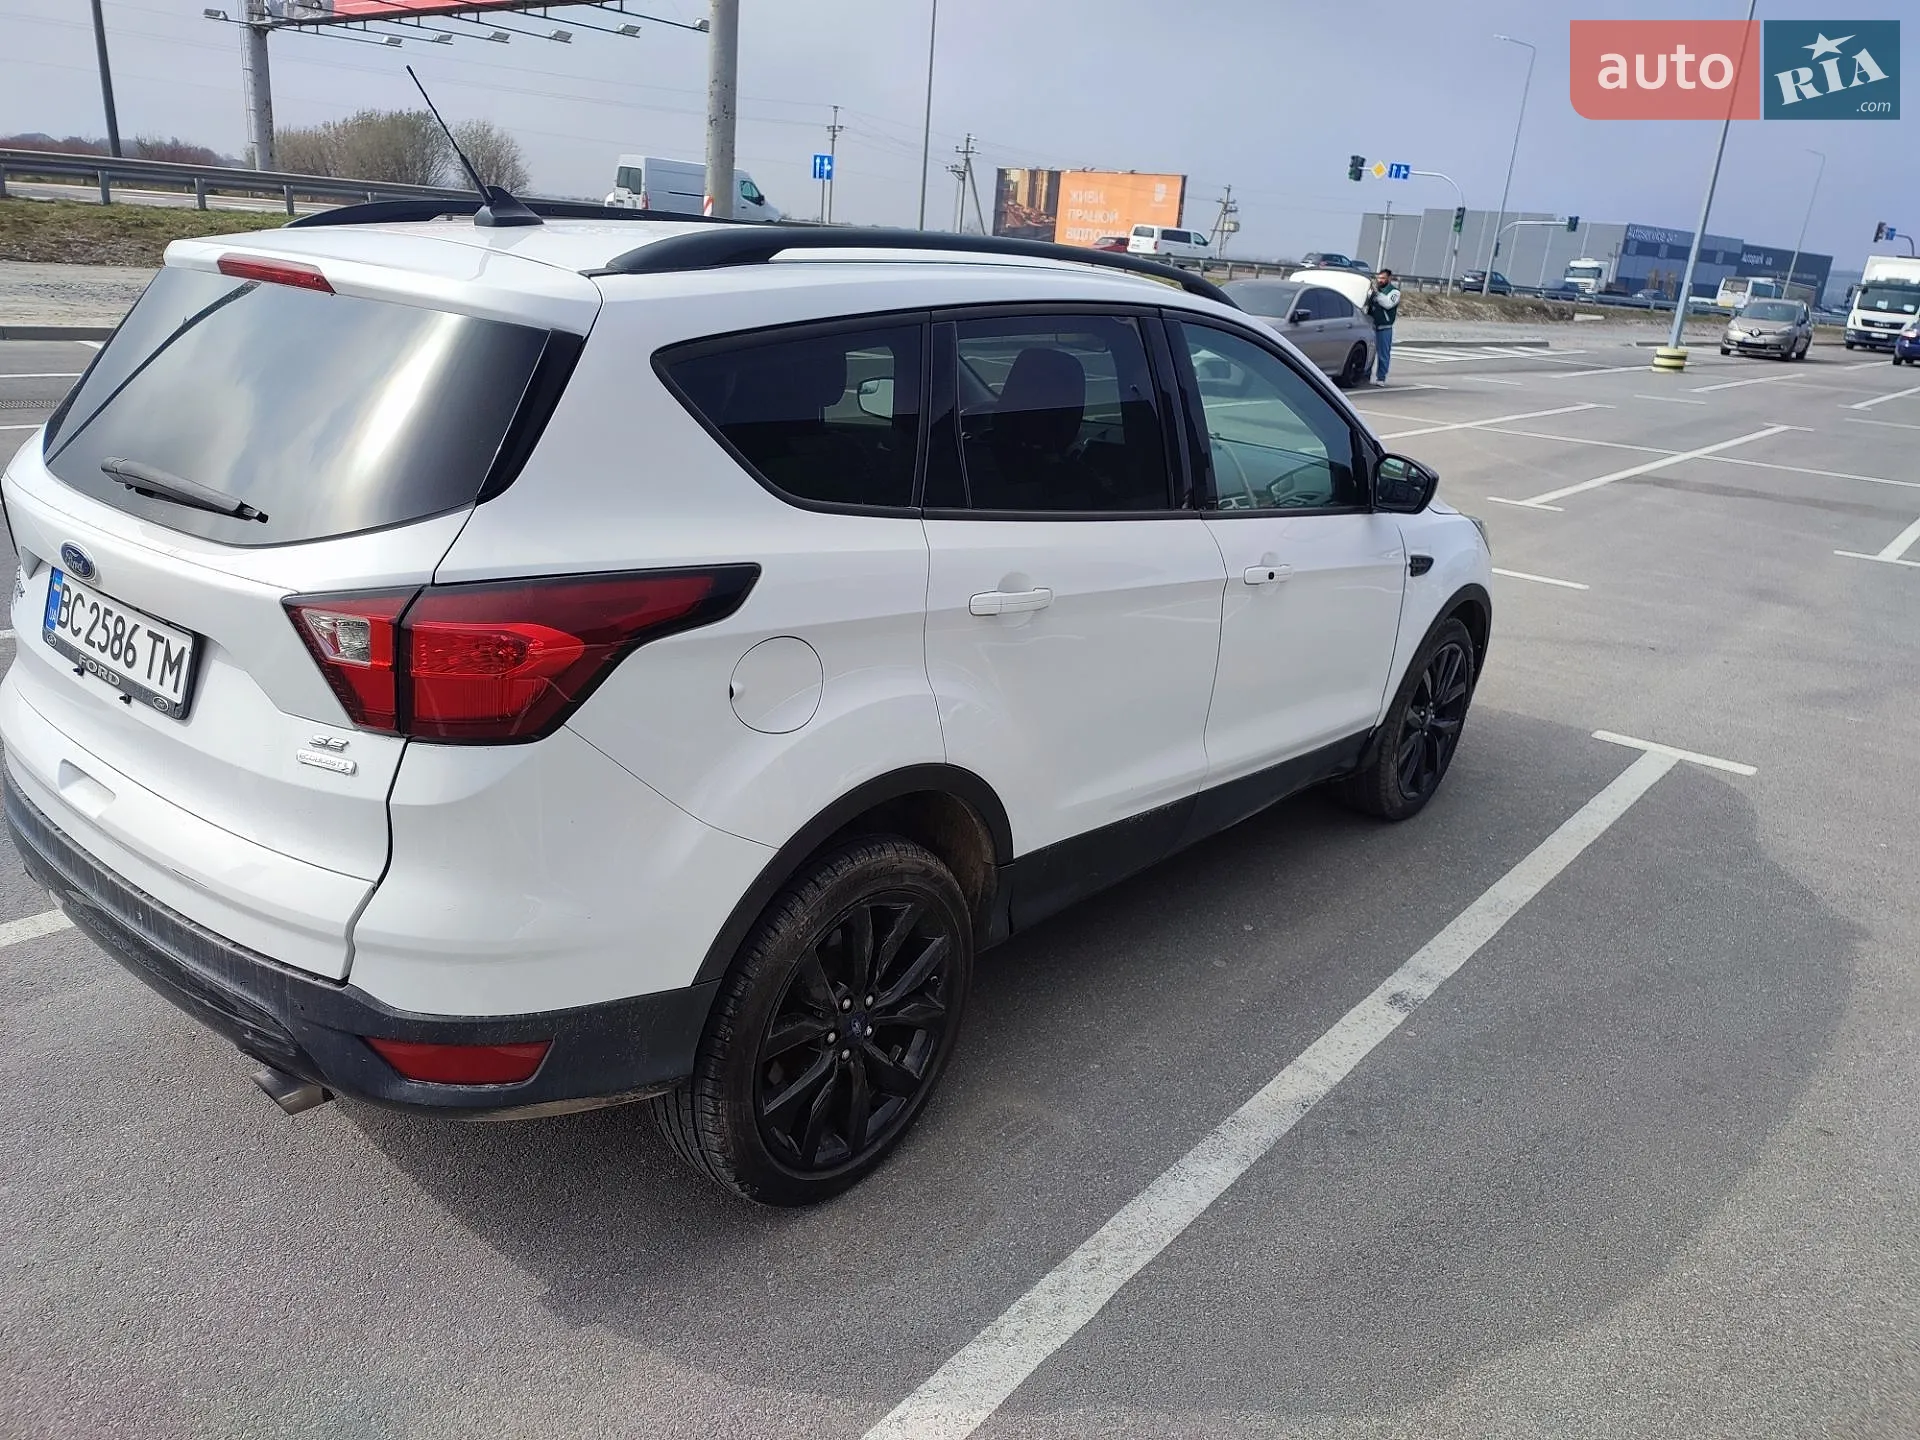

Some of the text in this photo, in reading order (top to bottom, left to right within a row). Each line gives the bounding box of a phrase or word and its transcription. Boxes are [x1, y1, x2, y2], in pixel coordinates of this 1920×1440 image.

[57, 582, 86, 637] BC
[84, 601, 140, 669] 2586
[146, 629, 186, 694] TM
[78, 653, 120, 686] FORD
[308, 735, 349, 752] SE
